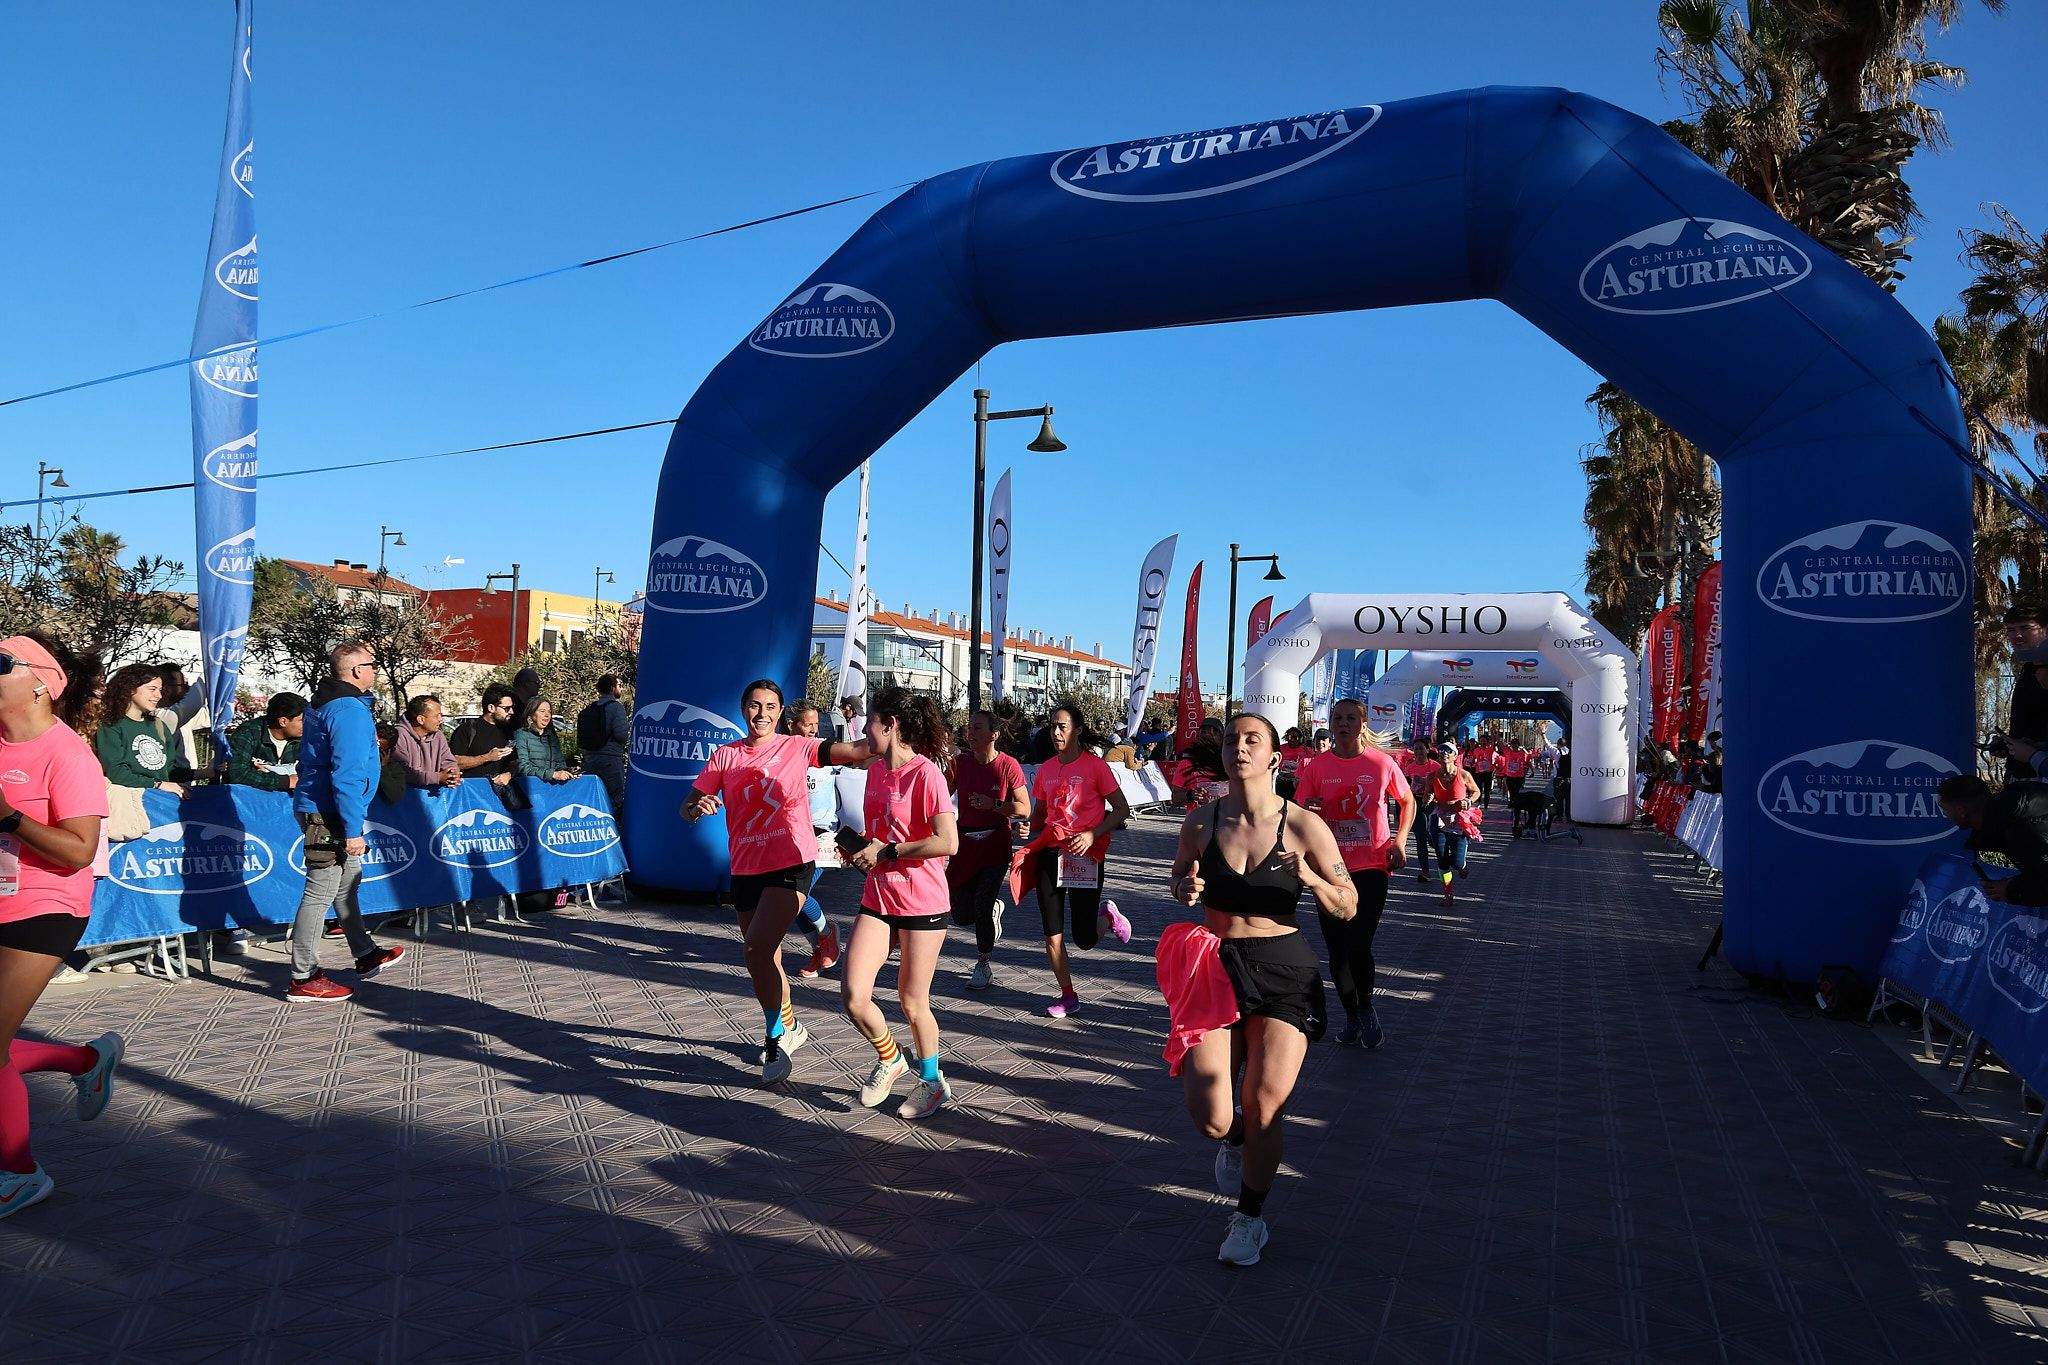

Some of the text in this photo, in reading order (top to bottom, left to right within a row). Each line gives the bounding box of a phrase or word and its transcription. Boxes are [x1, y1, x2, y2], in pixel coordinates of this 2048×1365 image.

[1070, 113, 1351, 181] ASTURIANA
[1629, 243, 1785, 266] CENTRAL LECHERA
[1597, 255, 1798, 300] ASTURIANA
[780, 305, 877, 319] CENTRAL LECHERA
[754, 318, 882, 343] ASTURIANA
[656, 562, 751, 575] CENTRAL LECHERA
[1804, 555, 1954, 568] CENTRAL LECHERA
[647, 565, 755, 599] ASTURIANA
[1770, 562, 1959, 600] ASTURIANA
[1353, 605, 1508, 635] OYSHO
[1267, 637, 1310, 648] OYSHO
[1554, 638, 1604, 649] OYSHO
[1663, 628, 1675, 695] Santander
[1246, 694, 1286, 704] OYSHO
[1477, 697, 1546, 705] VOLVO
[1186, 691, 1200, 739] Sports
[1580, 703, 1627, 714] OYSHO
[640, 725, 735, 740] CENTRAL LECHERA
[1579, 766, 1626, 777] OYSHO
[1805, 775, 1885, 786] CENTRAL
[1771, 775, 1948, 818] ASTURIAN
[582, 819, 610, 827] LECHERA
[547, 825, 617, 846] ASTURIANA
[146, 844, 256, 855] CENTRAL LECHERA
[440, 836, 523, 857] ASTURIANA
[120, 850, 265, 880] ASTURIANA
